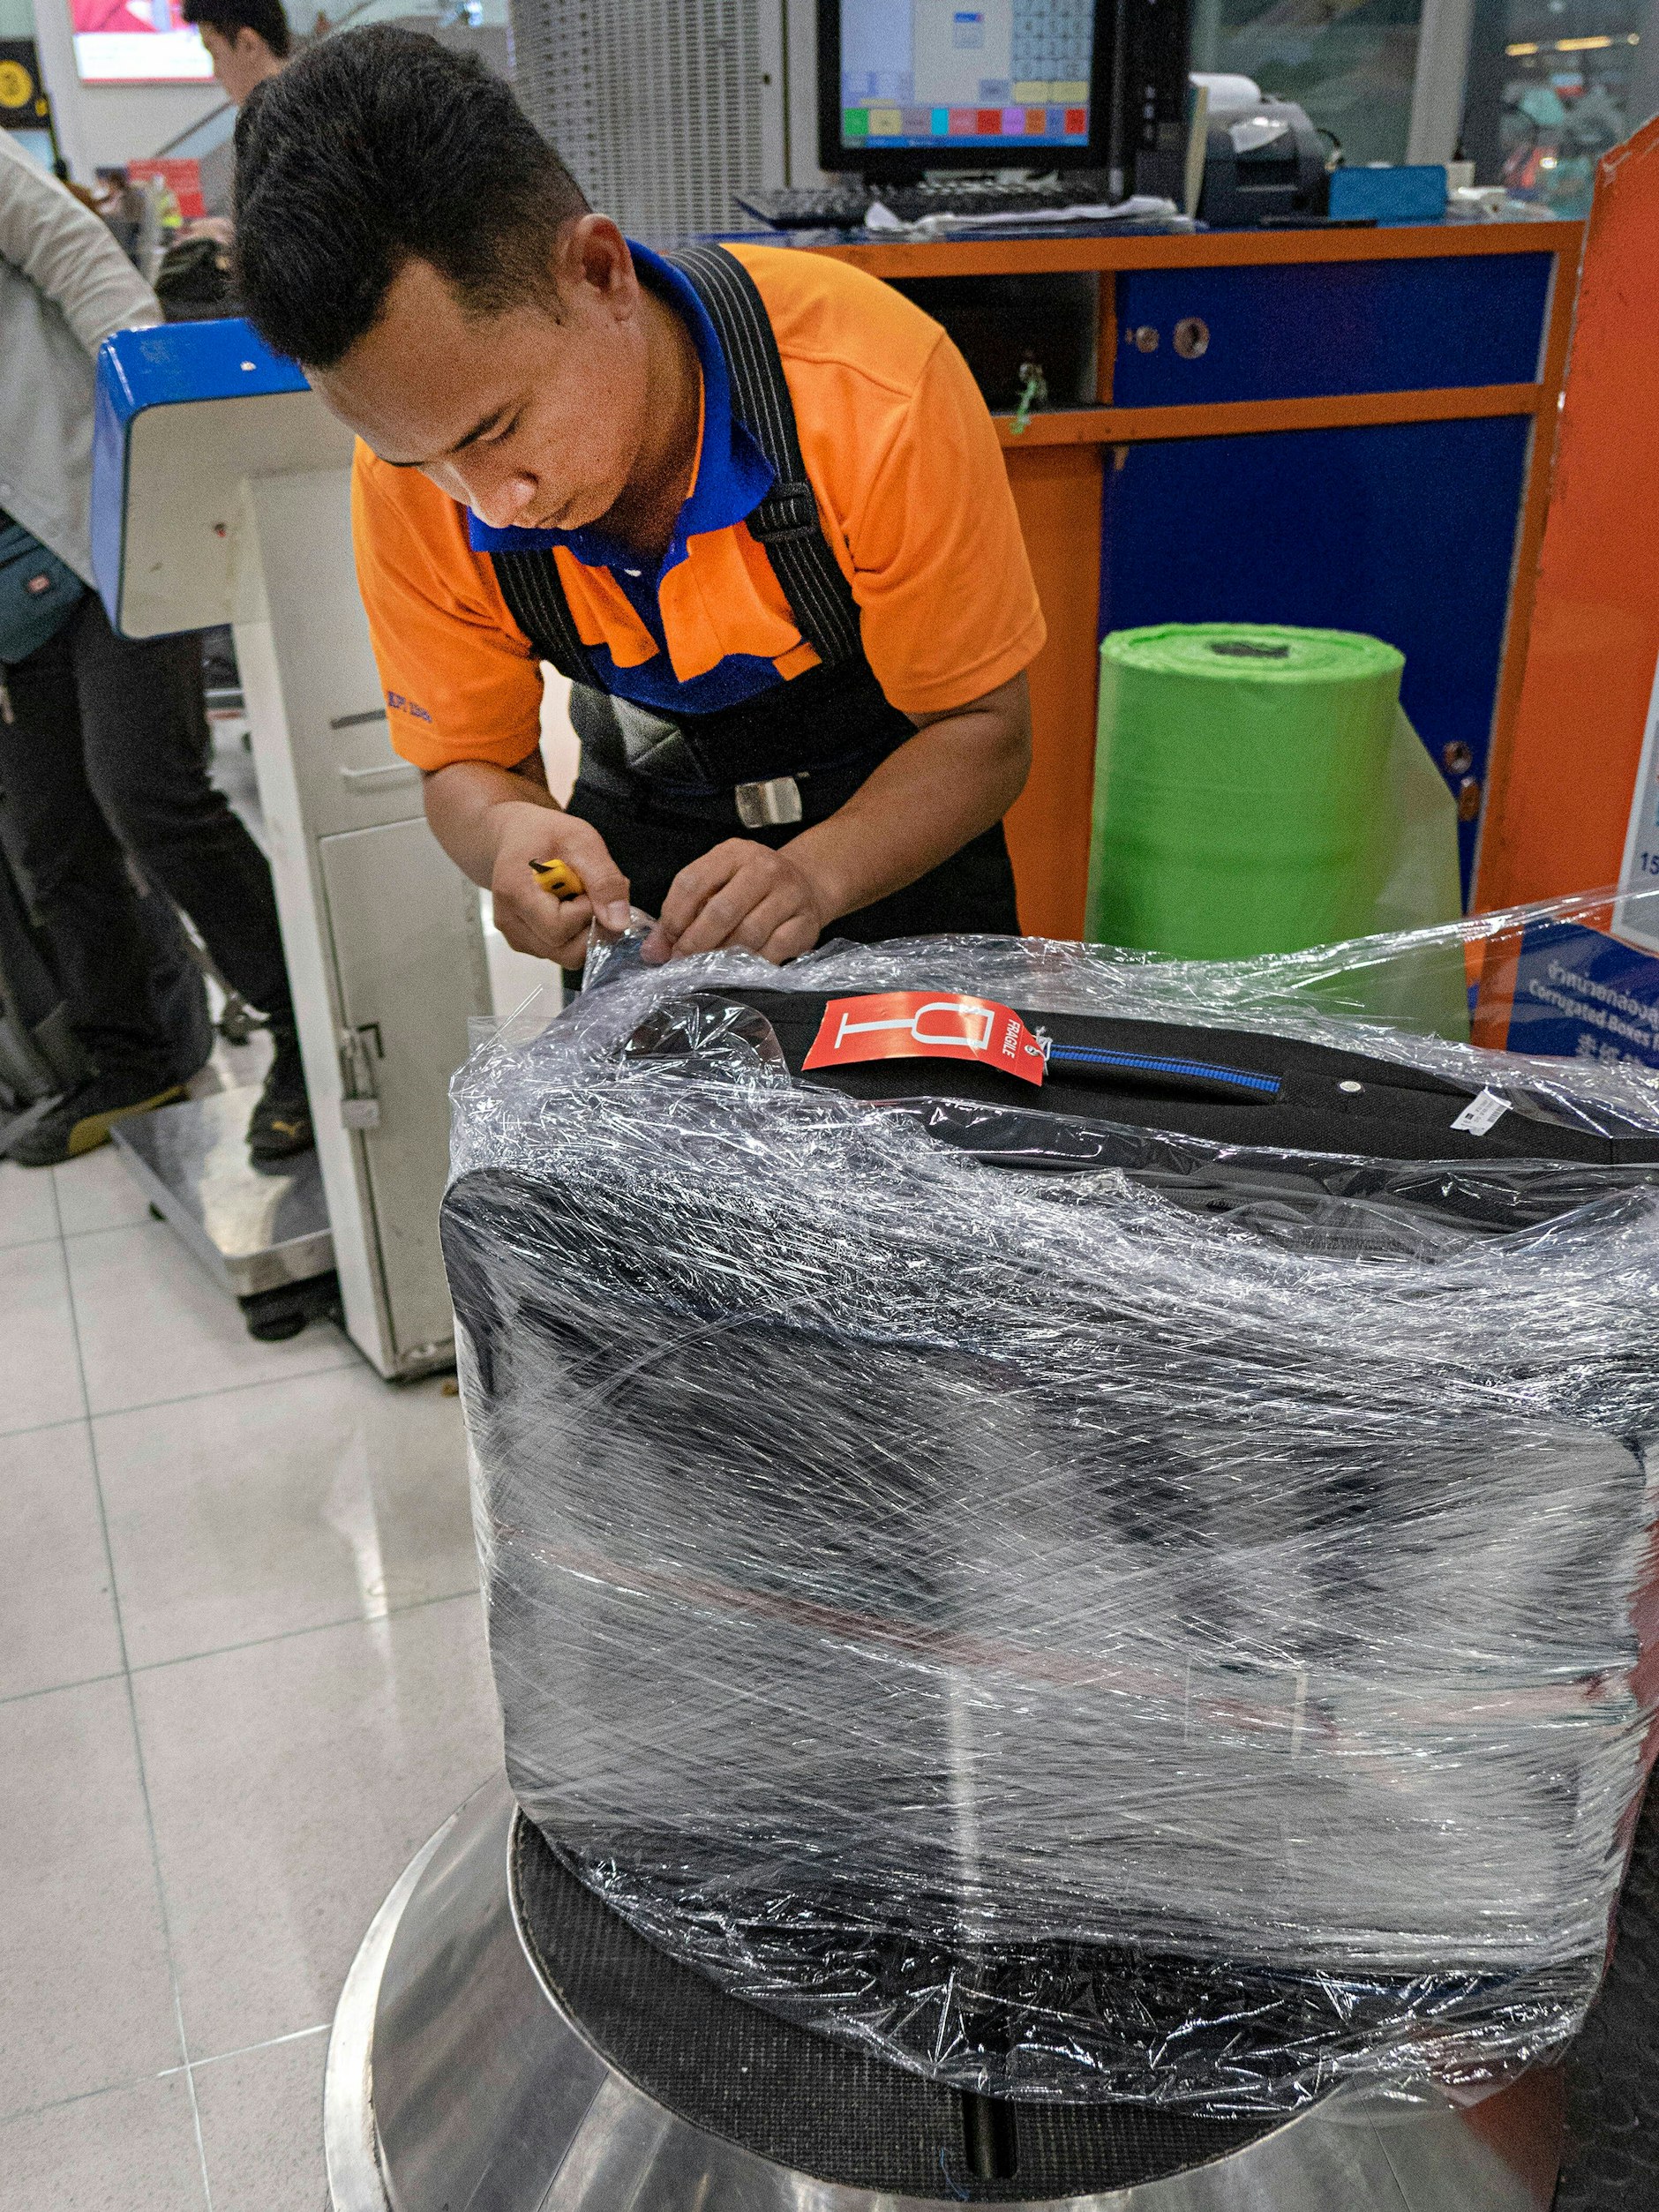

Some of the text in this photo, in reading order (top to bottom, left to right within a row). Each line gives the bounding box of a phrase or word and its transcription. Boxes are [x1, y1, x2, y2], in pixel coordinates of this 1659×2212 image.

[1002, 1018, 1021, 1059] FRAGILE
[1528, 979, 1607, 1029] Corrugated
[1607, 1015, 1651, 1048] Boxes
